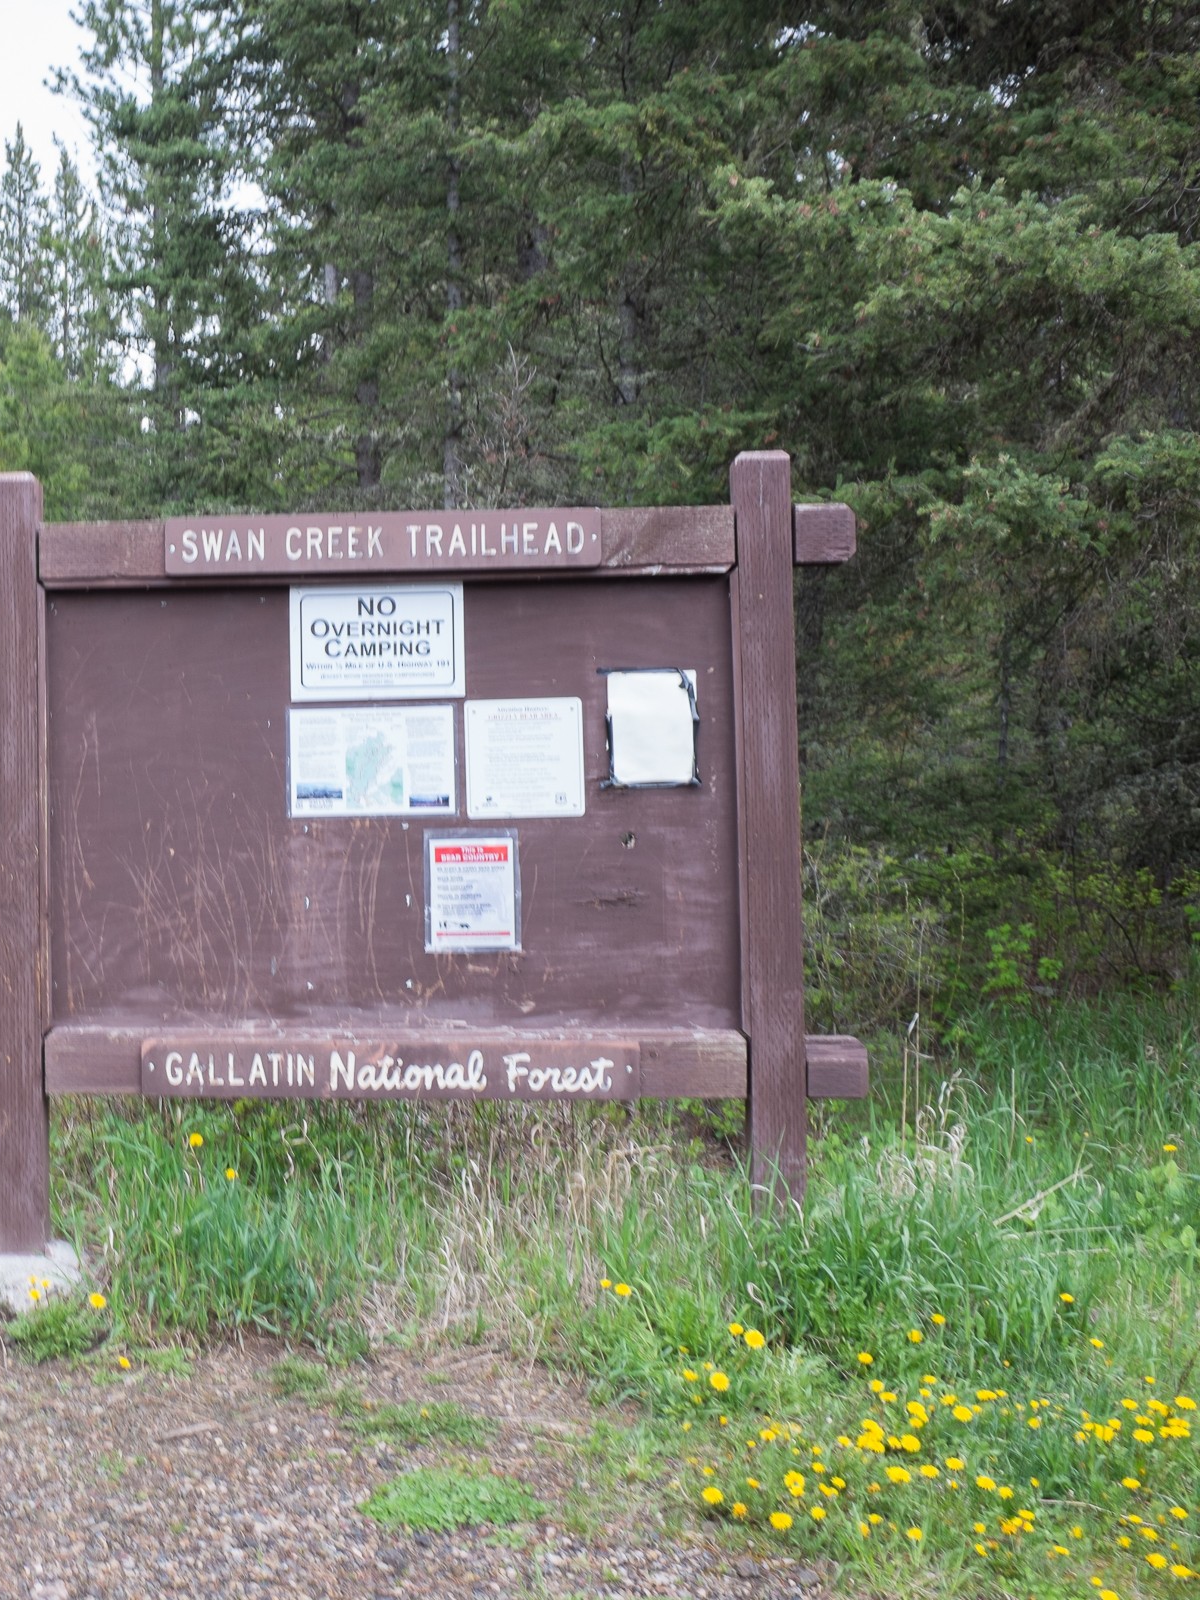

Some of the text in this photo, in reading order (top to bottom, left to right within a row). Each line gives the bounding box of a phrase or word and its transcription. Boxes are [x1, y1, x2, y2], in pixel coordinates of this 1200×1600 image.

[182, 521, 586, 564] SWAN CREEK TRAILHEAD
[357, 596, 397, 617] NO
[310, 618, 445, 638] OVERNIGHT
[324, 638, 431, 658] CAMPING
[165, 1049, 614, 1093] GALLATIN National Forest
